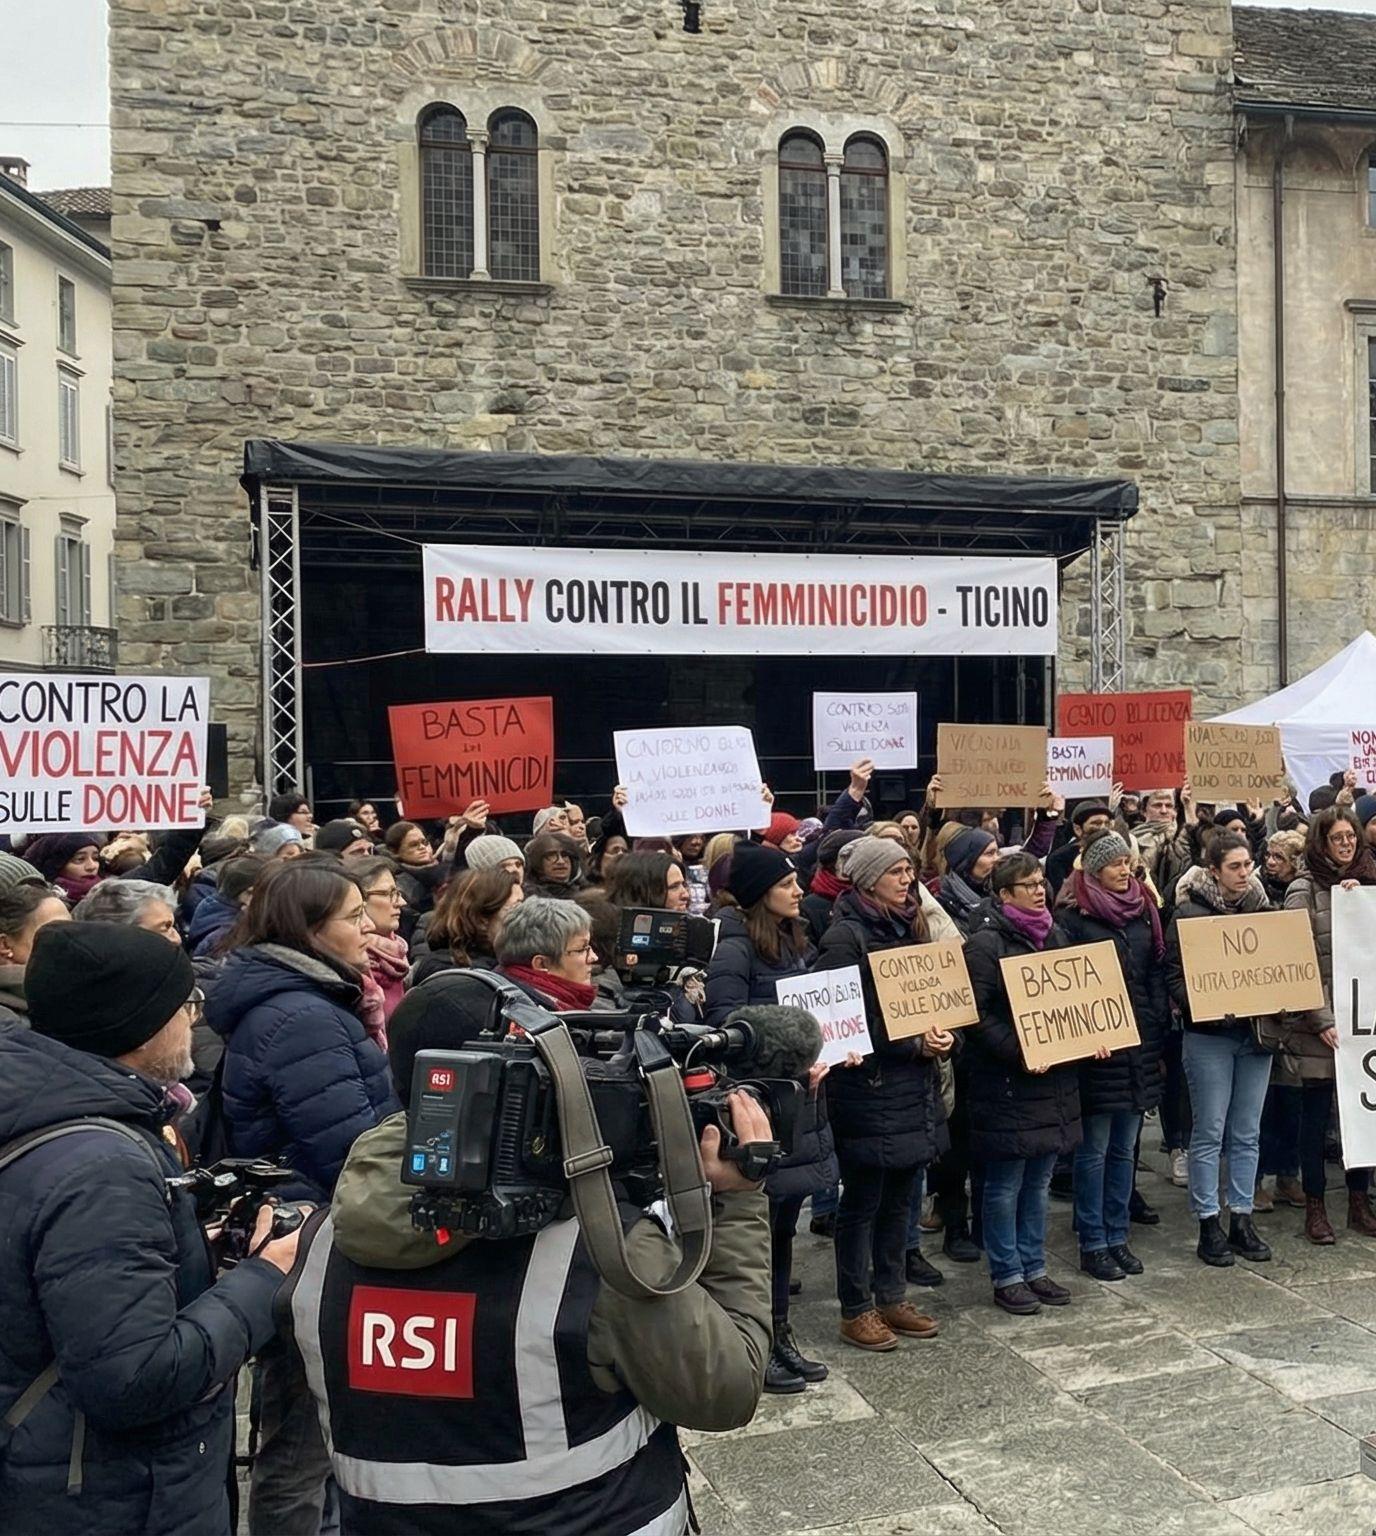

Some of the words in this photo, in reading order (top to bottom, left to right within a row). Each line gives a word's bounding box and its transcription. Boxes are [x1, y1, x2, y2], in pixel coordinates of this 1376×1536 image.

[435, 576, 535, 622] RALLY
[545, 578, 670, 625] CONTRO
[681, 582, 708, 625] IL
[718, 582, 928, 627] FEMMINICIDIO
[956, 585, 1049, 628] TICINO
[0, 680, 147, 723] CONTRO
[161, 685, 200, 722] LA
[422, 704, 525, 740] BASTA
[0, 730, 198, 778] VIOLENZA
[1052, 746, 1086, 759] BASTA
[1194, 751, 1258, 769] VIOLENZA
[402, 755, 548, 799] FEMMINICIDI
[0, 790, 72, 823] SULLE
[83, 783, 199, 824] DONNE
[694, 802, 740, 819] DONNE
[1222, 926, 1259, 956] NO
[880, 954, 935, 978] CONTRO
[938, 950, 957, 969] LA
[1020, 955, 1102, 998] BASTA
[888, 996, 929, 1019] SULLE
[930, 987, 973, 1012] DONNE
[1018, 993, 1130, 1047] FEMMINICIDI
[362, 1312, 457, 1371] RSI
